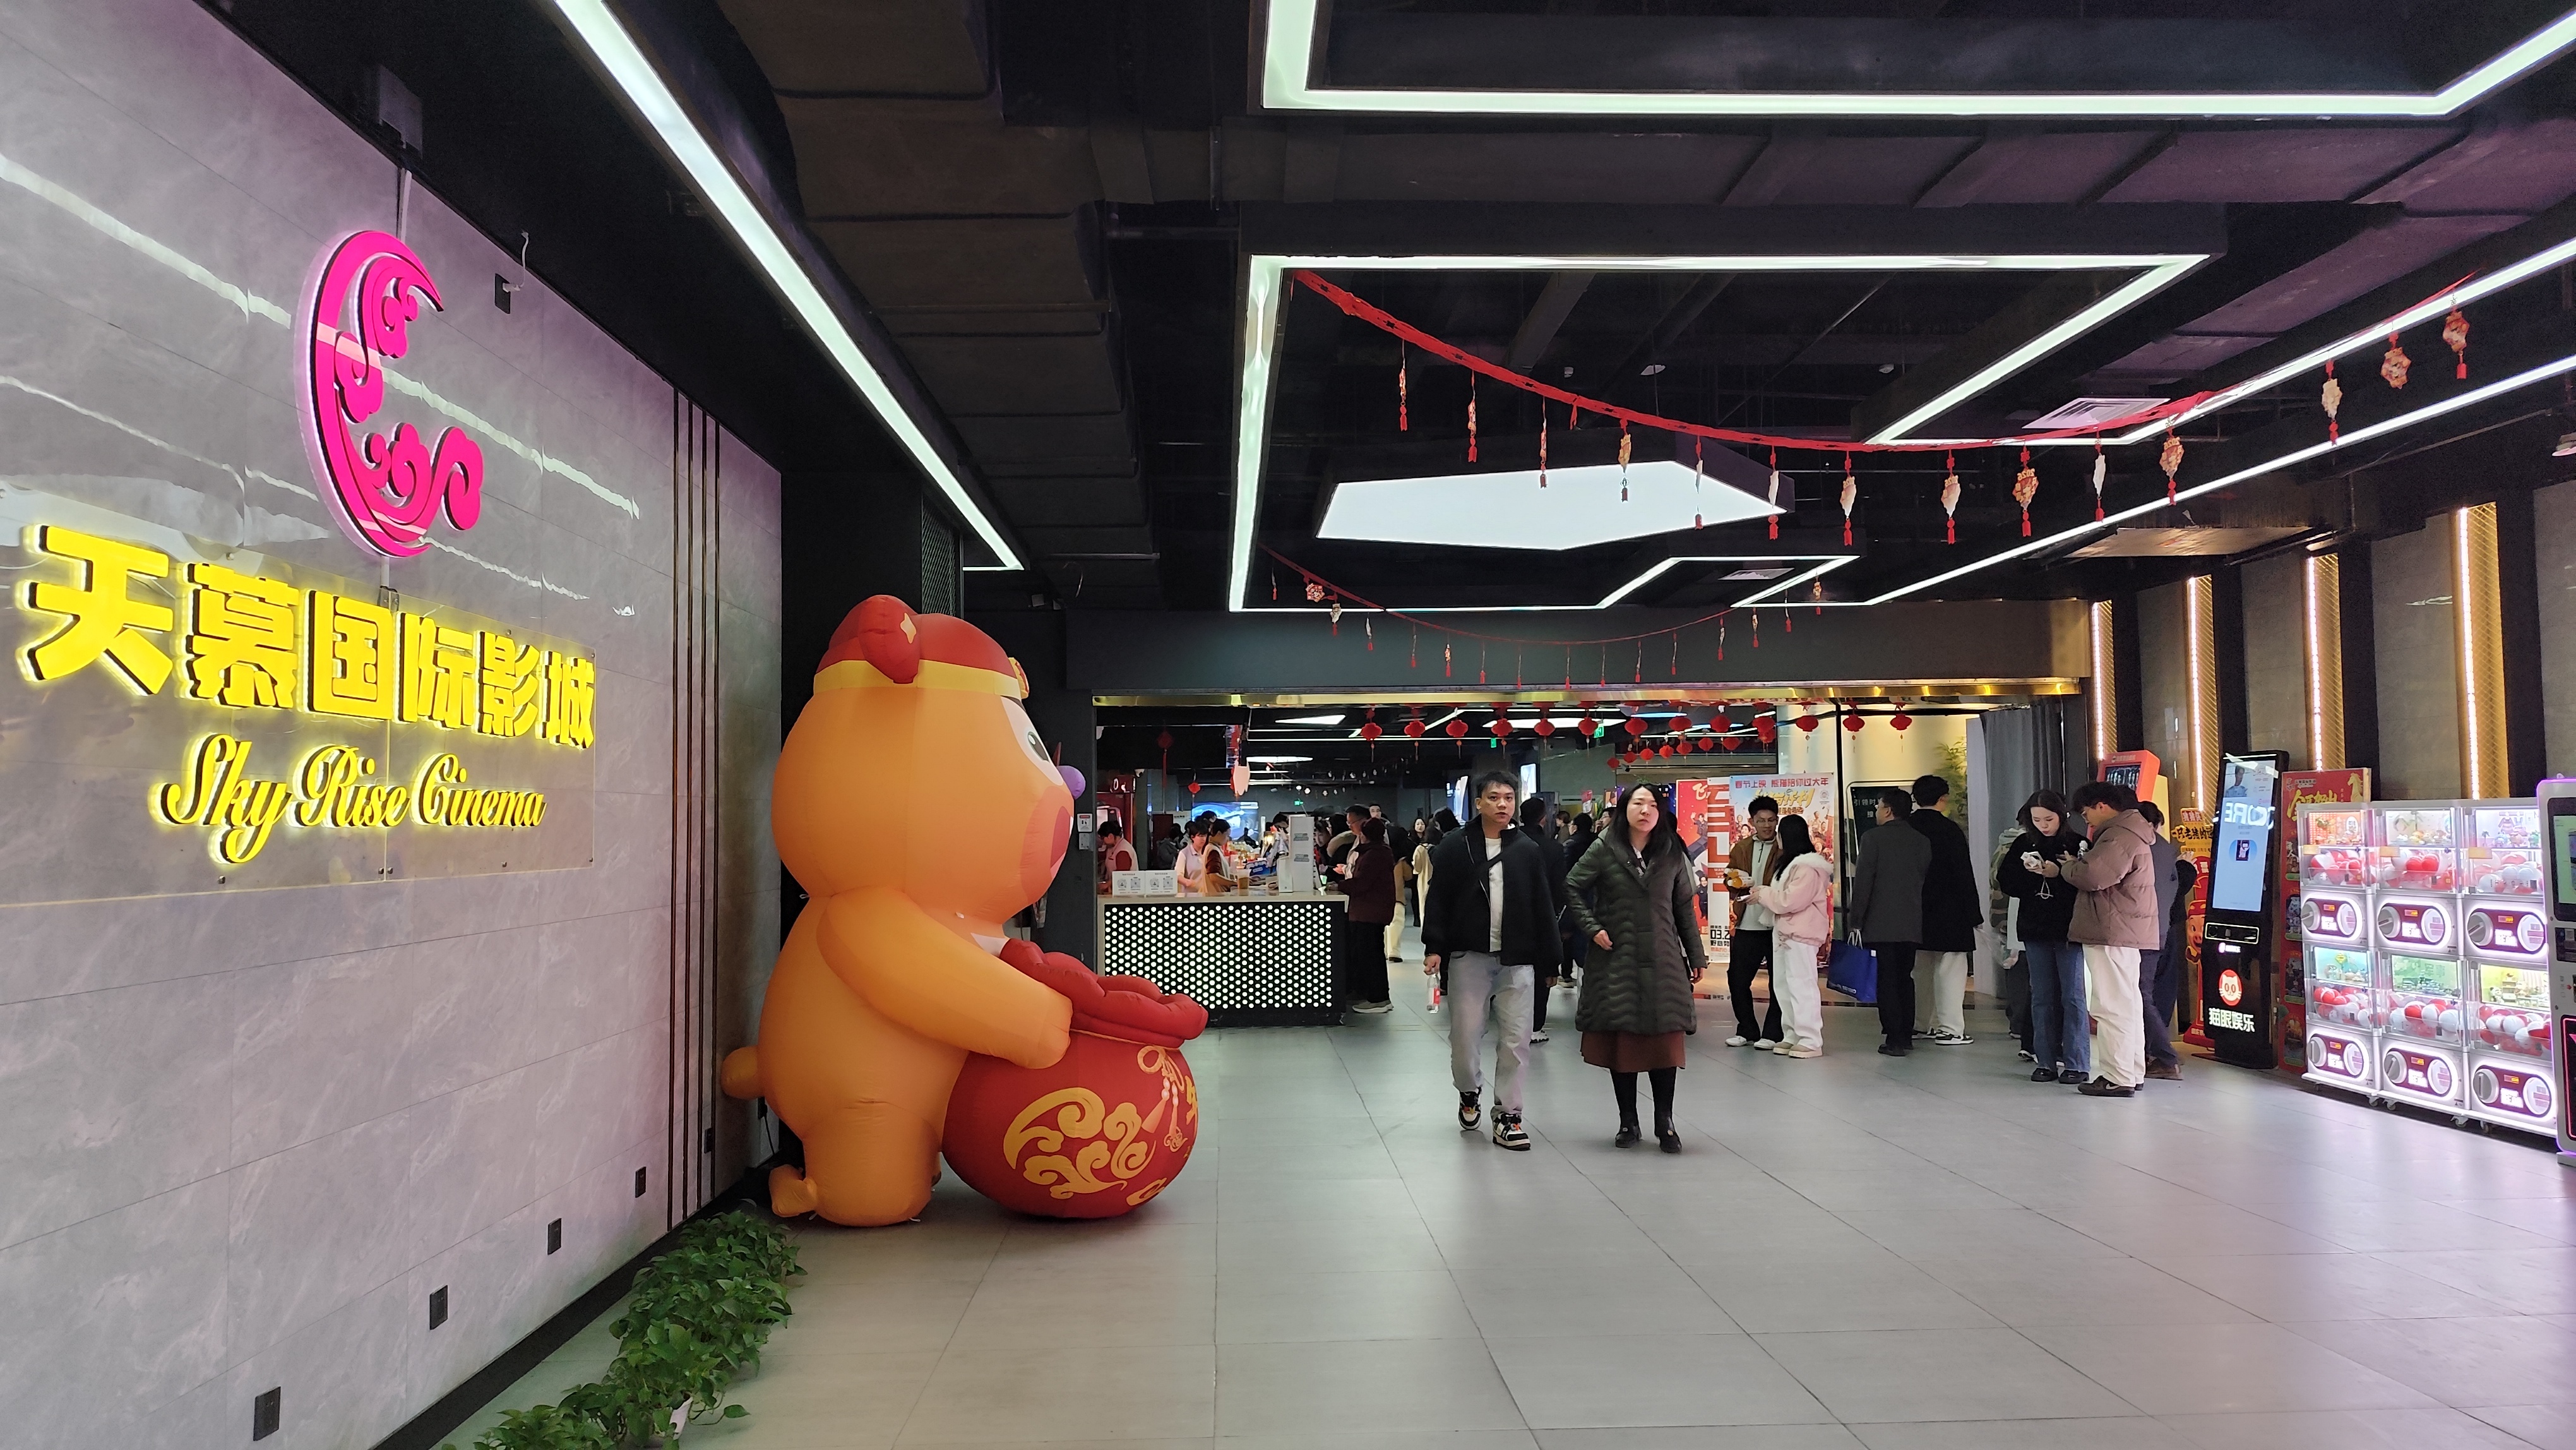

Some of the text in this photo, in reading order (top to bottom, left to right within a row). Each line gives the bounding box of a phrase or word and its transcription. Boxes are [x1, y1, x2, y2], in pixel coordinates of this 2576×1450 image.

[19, 523, 595, 750] 天幕国际影城
[1735, 777, 1828, 789] 春节上映 熊猫陪你过大年
[155, 733, 546, 864] Sky Rise Cinema
[1854, 798, 1880, 806] 引领时
[1710, 930, 1731, 940] 03.2
[2209, 1007, 2255, 1033] 猫眼娱乐
